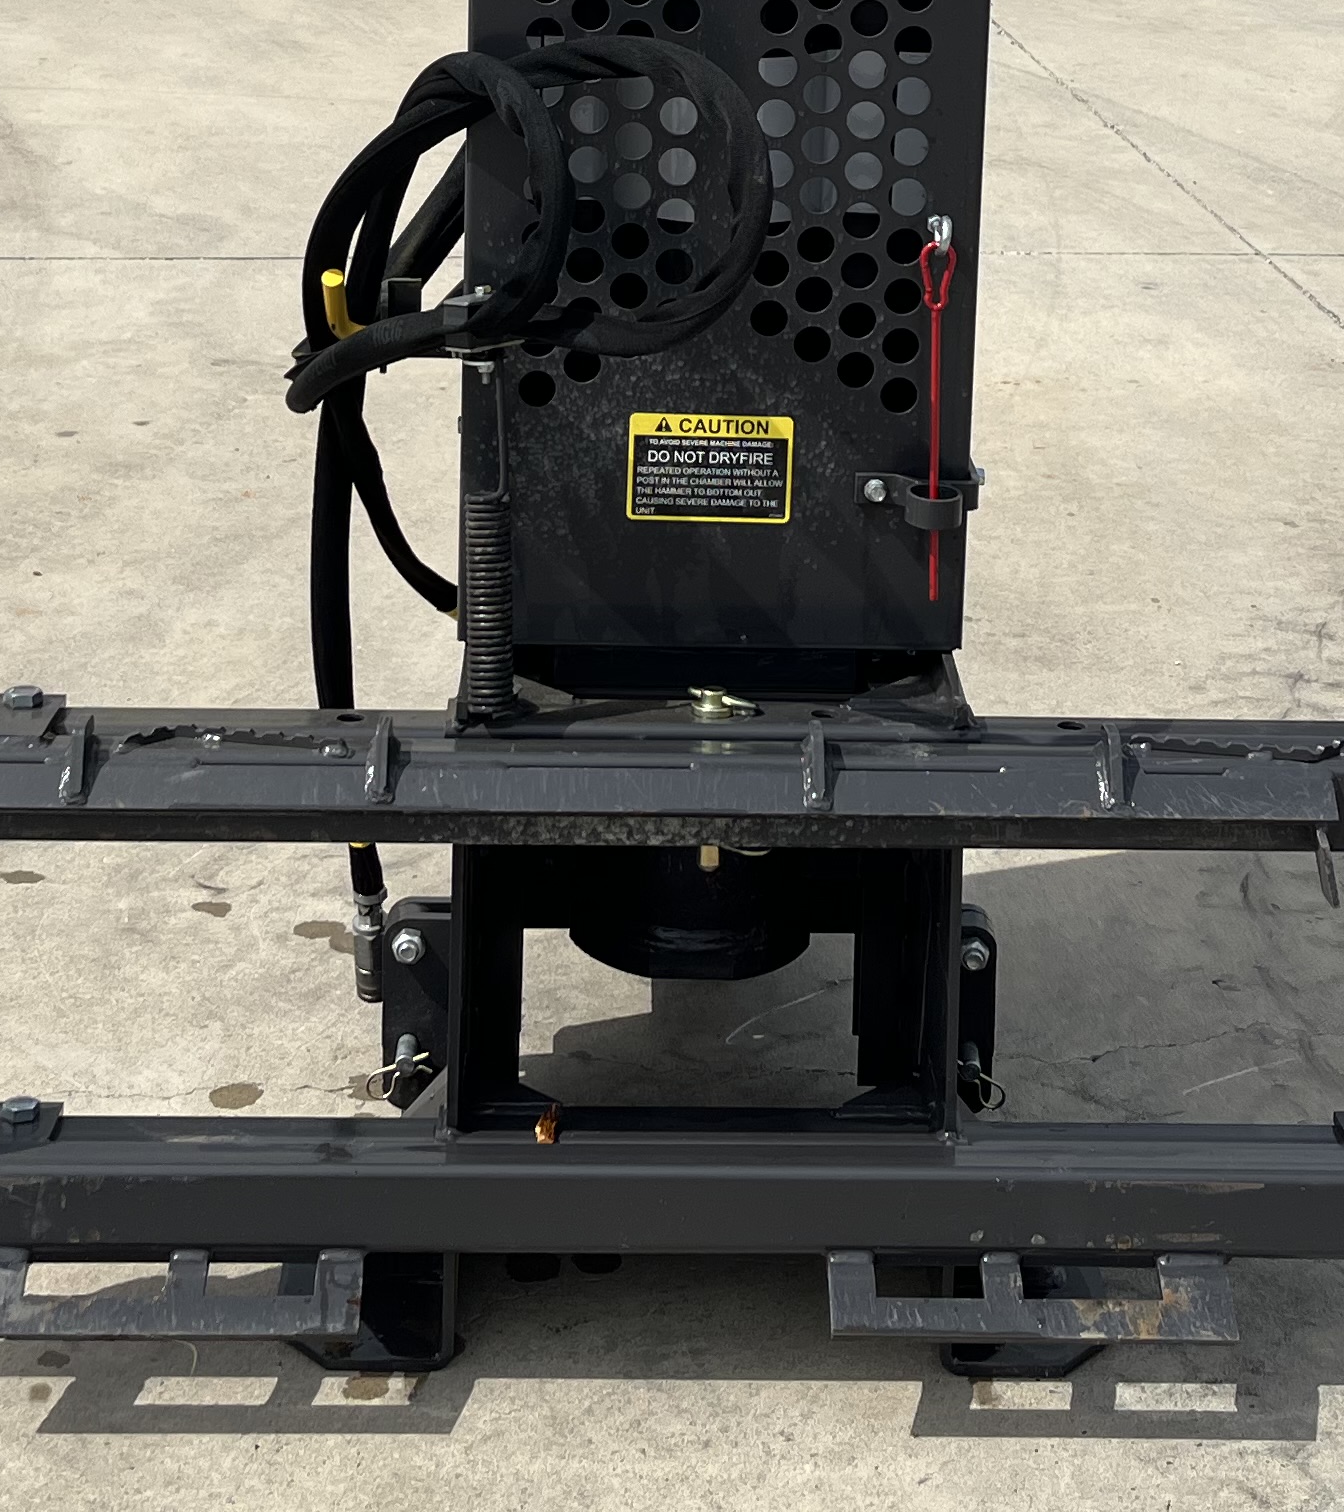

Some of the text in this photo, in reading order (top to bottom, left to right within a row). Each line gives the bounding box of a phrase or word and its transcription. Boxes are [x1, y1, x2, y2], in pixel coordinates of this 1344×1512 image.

[679, 418, 769, 435] CAUTION
[681, 439, 708, 447] SEVERE
[709, 440, 741, 448] MACHINE
[647, 449, 774, 466] DO NOT DRYFIRE
[636, 465, 779, 478] REPEATED OPERATION WITHOUT A
[636, 476, 784, 488] POST IN THE CHAMBER WILL ALLOW
[636, 486, 763, 498] THE HAMMER TO BOTTOM OUT
[635, 496, 779, 508] CAUSING SEVERE DAMAGE TO THE
